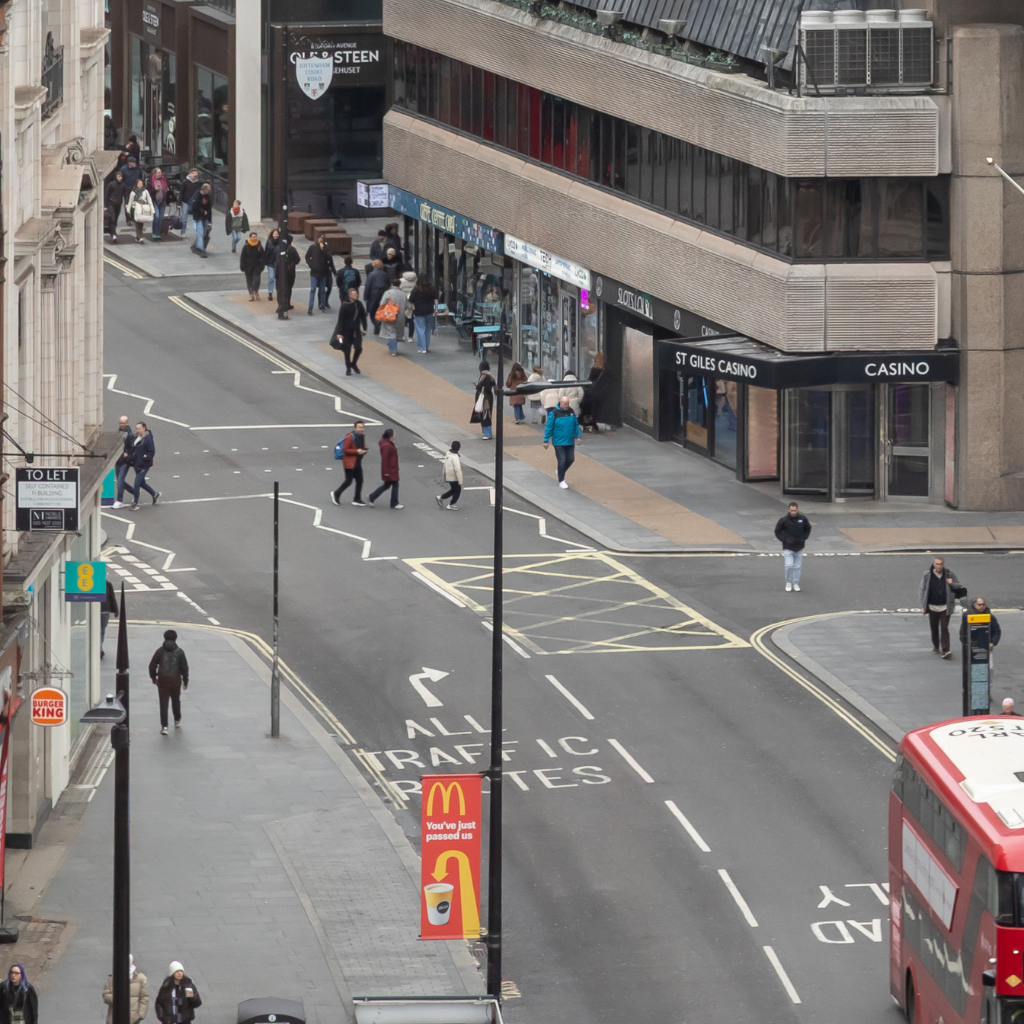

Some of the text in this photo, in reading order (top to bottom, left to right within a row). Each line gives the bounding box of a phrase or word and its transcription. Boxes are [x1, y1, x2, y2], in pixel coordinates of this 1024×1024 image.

[334, 50, 379, 63] STEEN
[675, 351, 757, 379] ST GILES CASINO
[864, 361, 930, 377] CASINO
[25, 469, 68, 481] TO LET
[33, 700, 64, 708] BURGER
[33, 707, 64, 717] KING
[405, 714, 506, 739] ALL
[356, 736, 599, 772] TRAFFIC
[388, 765, 612, 801] RTES
[426, 820, 476, 832] You've just
[426, 830, 473, 843] passed us
